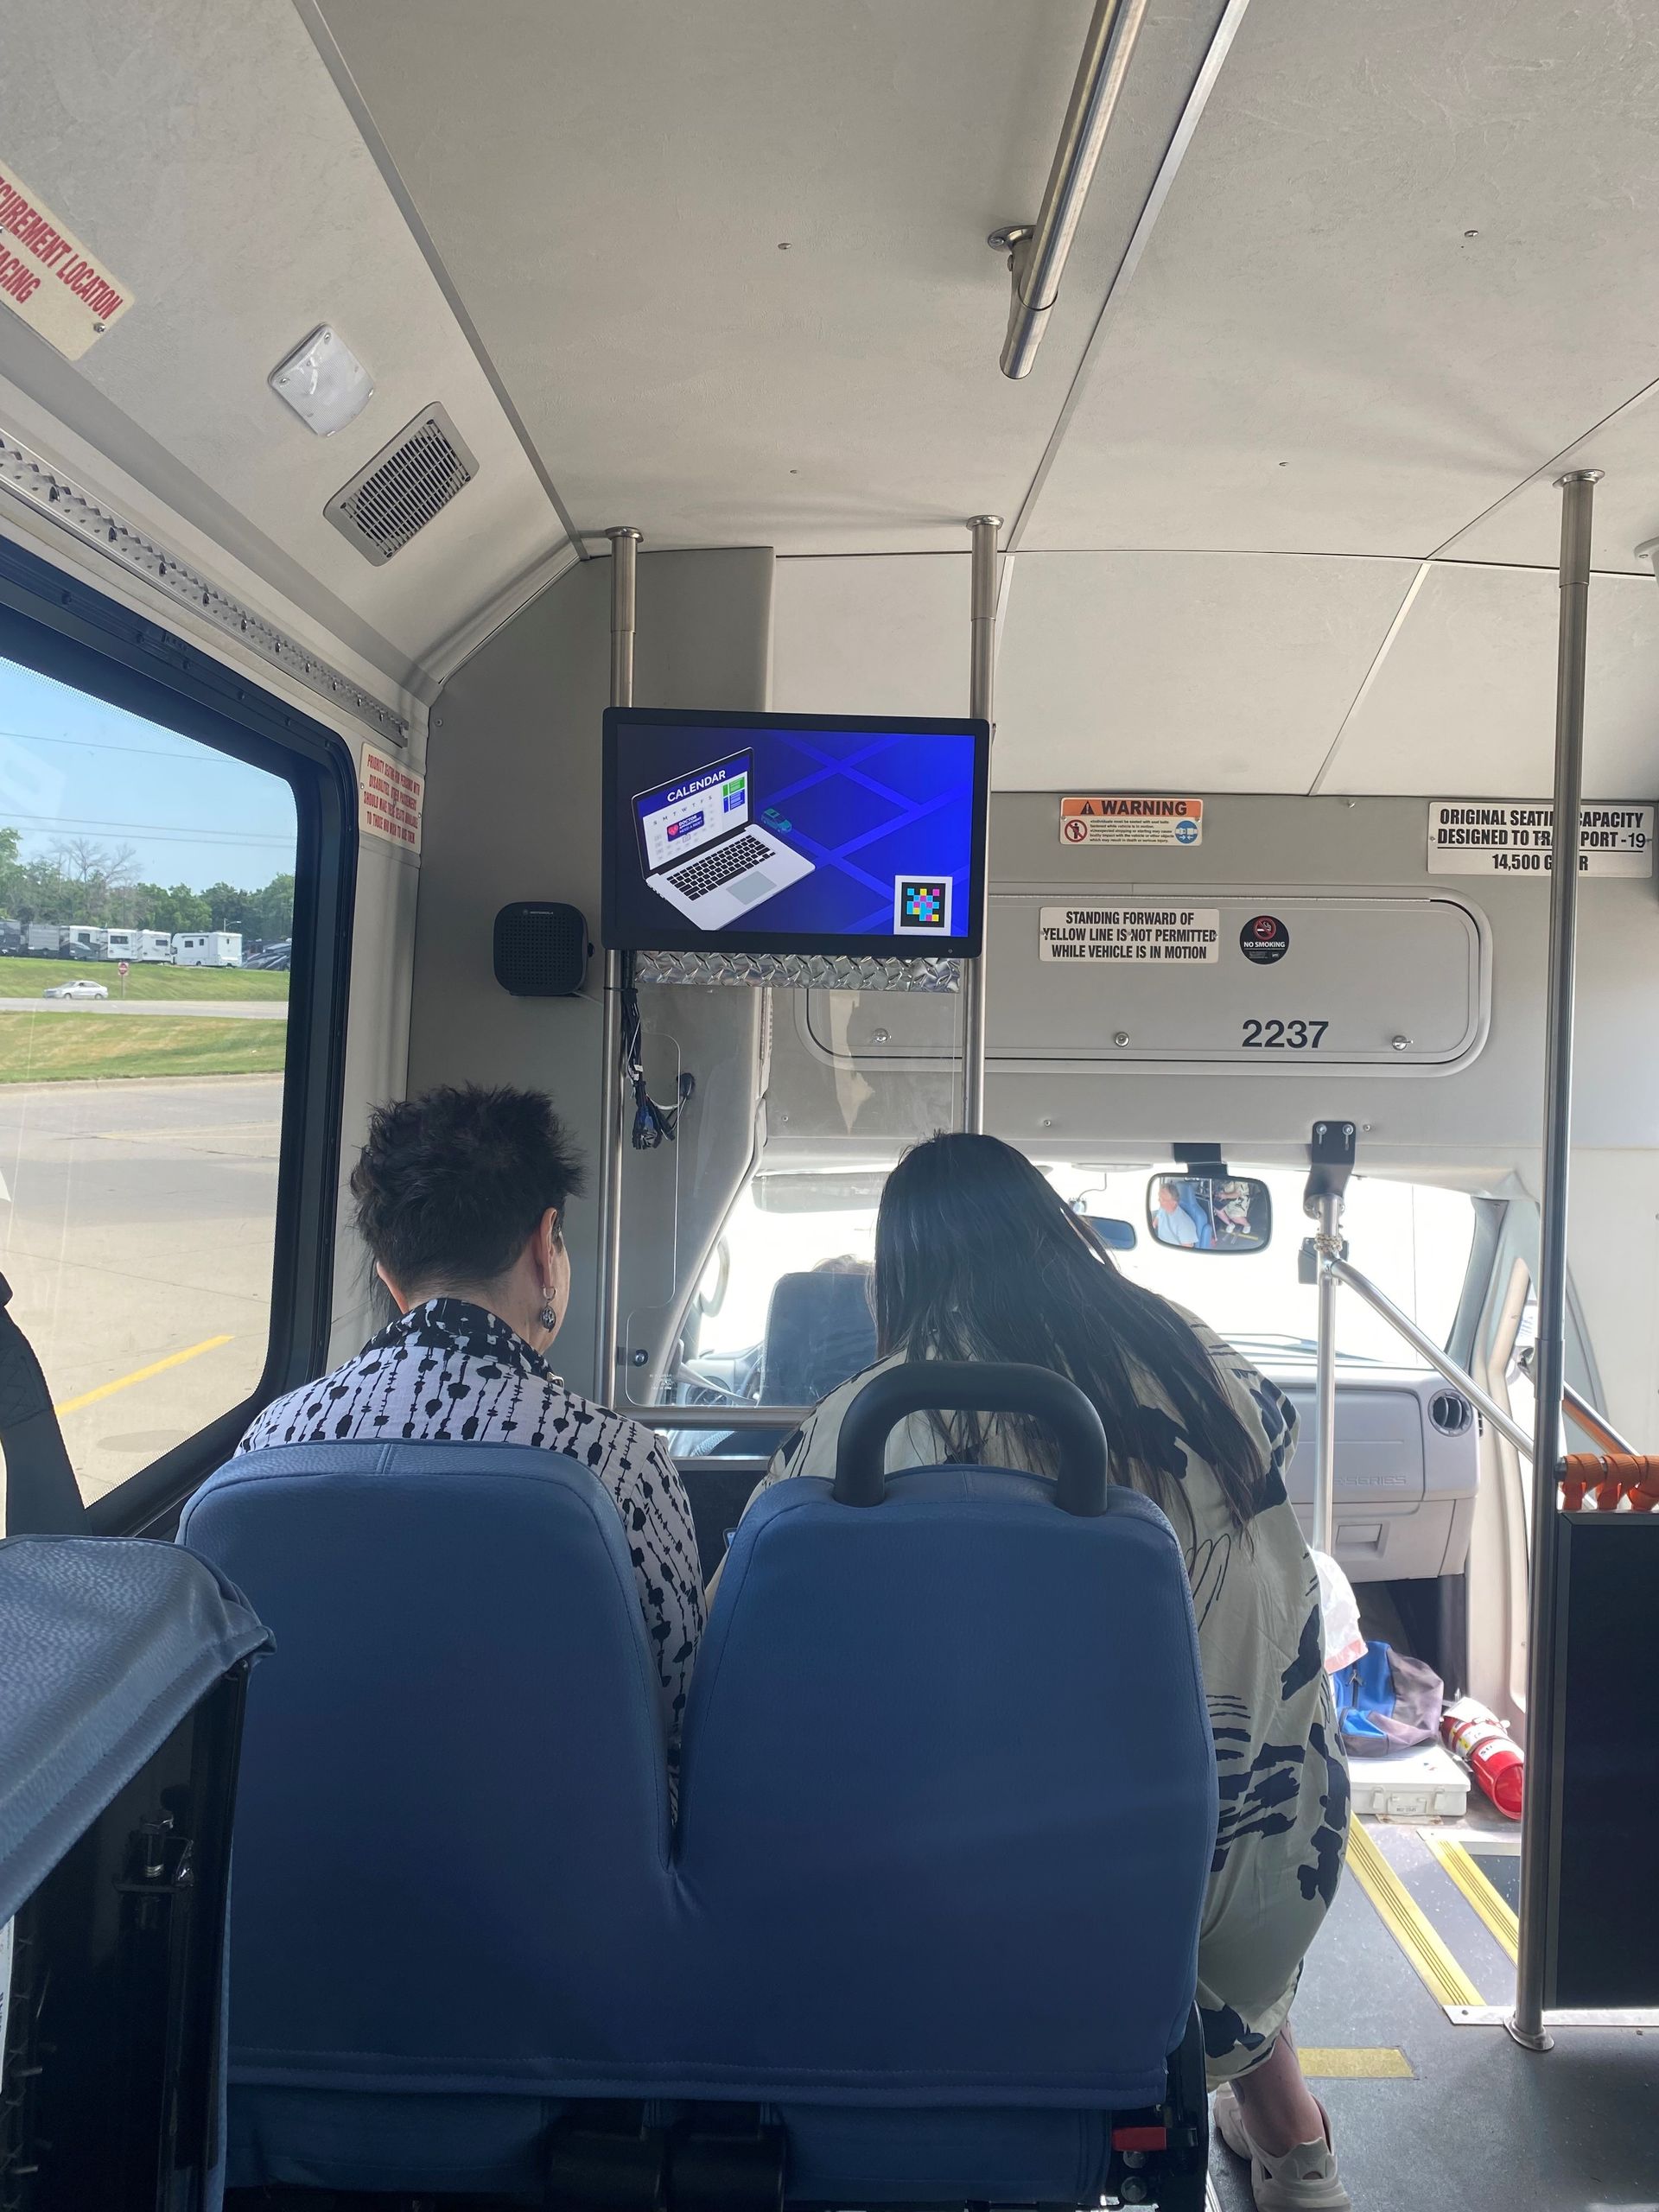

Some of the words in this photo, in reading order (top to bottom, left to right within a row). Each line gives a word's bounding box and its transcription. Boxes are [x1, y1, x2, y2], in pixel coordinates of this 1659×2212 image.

[56, 254, 124, 320] LOCATION
[667, 770, 726, 802] CALENDAR
[1101, 800, 1187, 816] WARNING
[1440, 809, 1507, 825] ORIGINAL
[1510, 810, 1554, 826] SEATI
[1580, 812, 1644, 829] APACITY
[1438, 829, 1509, 845] DESIGNED
[1511, 830, 1529, 846] TO
[1492, 854, 1541, 872] 14,500
[1065, 911, 1120, 925] STANDING
[1123, 912, 1177, 925] FORWARD
[1180, 912, 1194, 925] OF
[1043, 927, 1086, 941] YELLOW
[1090, 928, 1114, 942] LINE
[1116, 928, 1128, 942] IS
[1130, 929, 1153, 942] NOT
[1155, 929, 1217, 943] PERMITTED
[1052, 944, 1086, 957] WHILE
[1088, 944, 1133, 958] VEHICLE
[1136, 945, 1147, 959] IS
[1150, 945, 1161, 959] IN
[1165, 946, 1207, 959] MOTION
[1242, 1019, 1329, 1048] 2237
